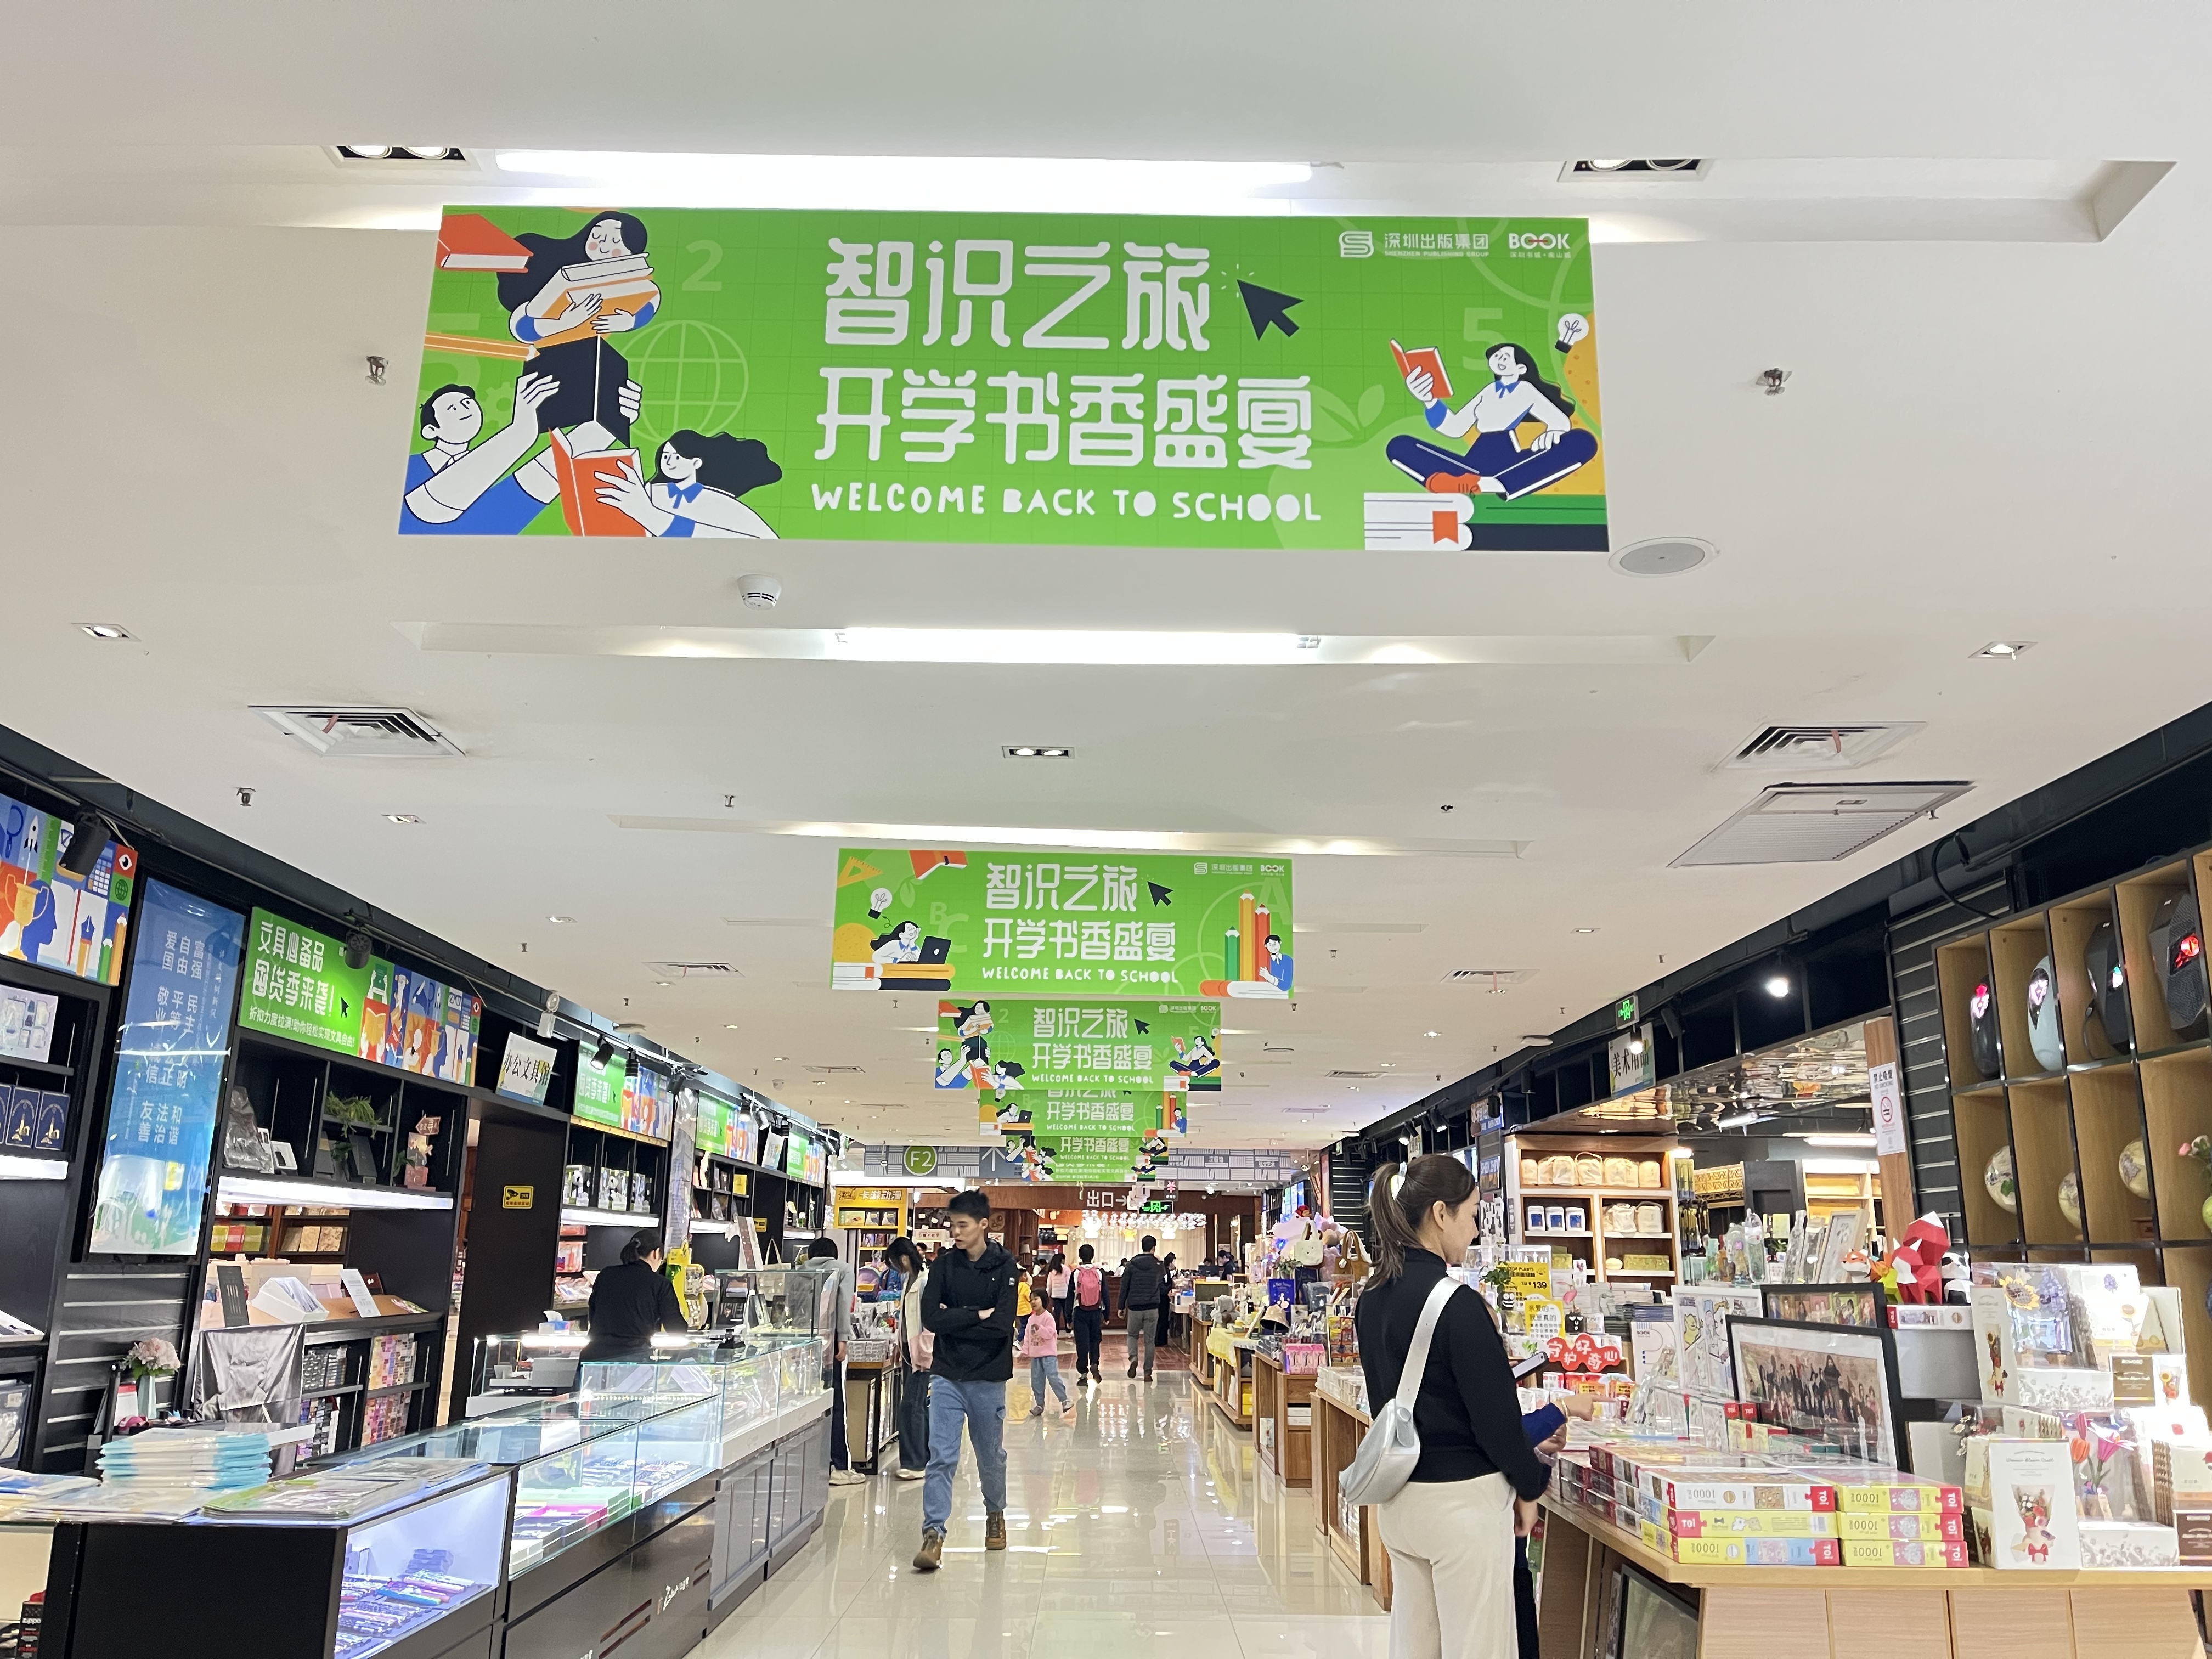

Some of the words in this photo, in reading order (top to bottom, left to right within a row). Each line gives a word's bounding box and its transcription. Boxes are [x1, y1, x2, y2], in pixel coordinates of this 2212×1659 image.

[1384, 233, 1489, 249] 深圳出版集团
[1509, 233, 1570, 250] BOOK
[825, 237, 1210, 351] 智识之旅
[814, 367, 1312, 469] 开学书香盛宴
[811, 482, 985, 515] WELCOME
[1003, 488, 1096, 516] BACK
[1113, 490, 1156, 517] TO
[1173, 492, 1321, 522] SCHOOL
[986, 862, 1137, 912] 智识之旅
[1260, 865, 1284, 873] BOOK
[162, 930, 178, 972] 爱国
[177, 936, 191, 975] 自由
[190, 939, 205, 980] 富强
[983, 918, 1176, 962] 开学书香盛宴
[252, 958, 335, 1018] 国货季来袭!
[982, 967, 1049, 980] WELCOME
[1056, 968, 1092, 980] BACK
[1098, 969, 1115, 981] TO
[1121, 970, 1178, 983] SCHOOL
[170, 990, 184, 1030] 平等
[185, 995, 199, 1034] 民主
[1034, 1007, 1128, 1039] 智识之旅
[1032, 1043, 1152, 1070] 开学书香盛宴
[1031, 1074, 1074, 1083] WELCOME
[1077, 1075, 1100, 1083] BACK
[1103, 1075, 1115, 1084] TO
[1118, 1075, 1154, 1084] SCHOOL
[138, 1099, 154, 1143] 友善
[154, 1103, 169, 1144] 法治
[168, 1105, 182, 1146] 和谐
[1047, 1101, 1134, 1121] 开学书香盛宴
[910, 1150, 933, 1167] F2
[1060, 1137, 1130, 1153] 开学书香盛宴
[860, 1190, 902, 1201] 卡游动漫
[1087, 1190, 1114, 1208] 出口
[1548, 1339, 1618, 1370] 守护好奇心
